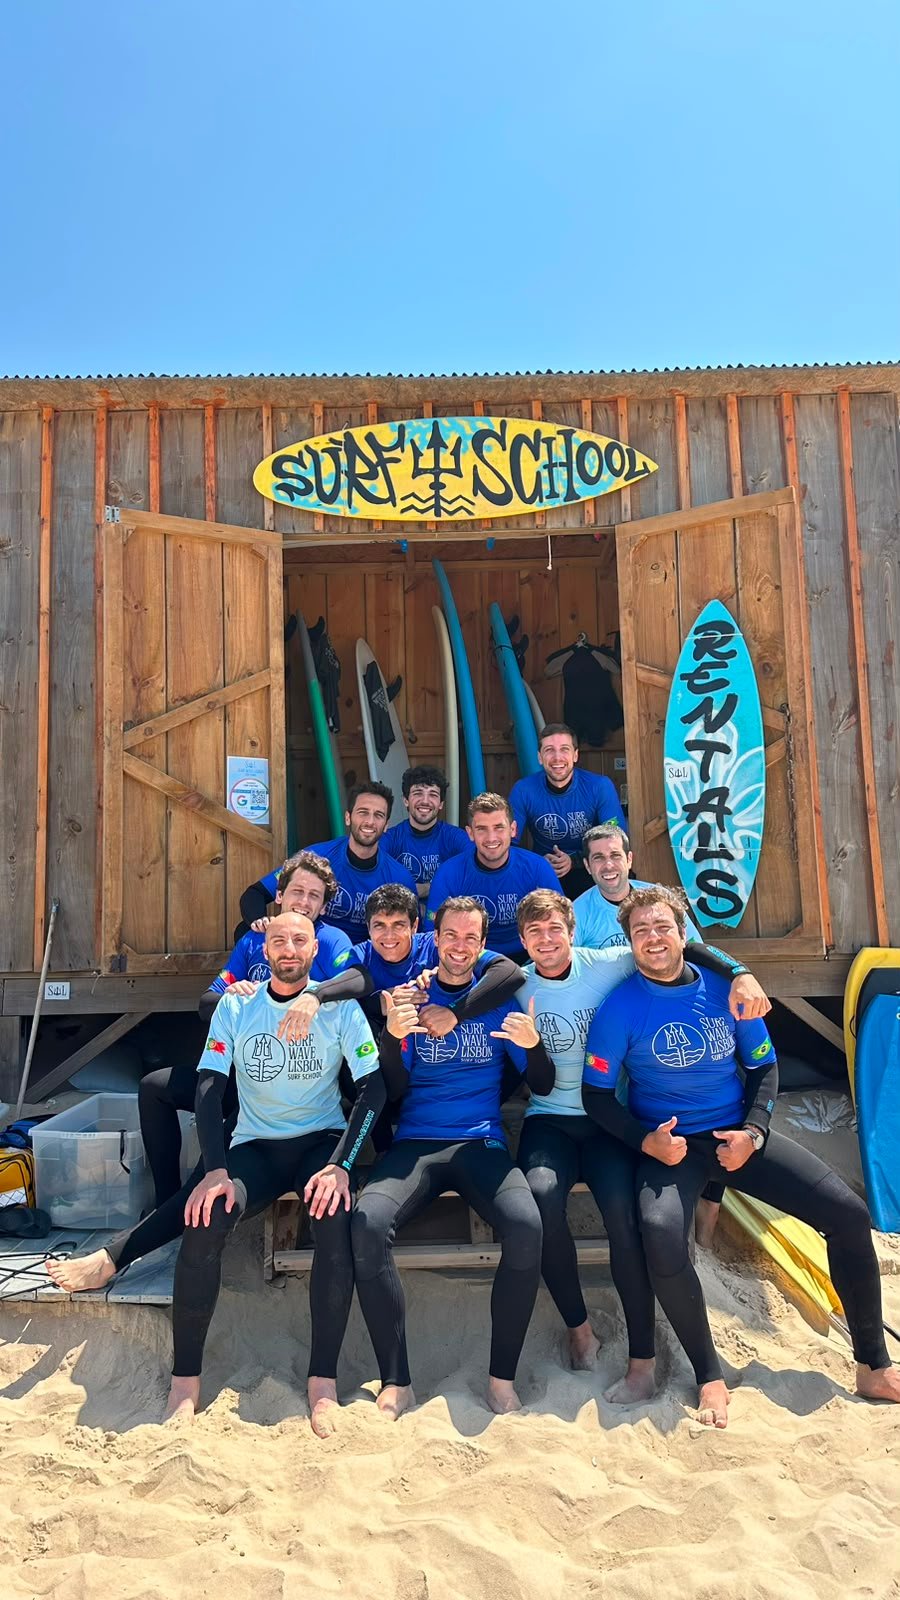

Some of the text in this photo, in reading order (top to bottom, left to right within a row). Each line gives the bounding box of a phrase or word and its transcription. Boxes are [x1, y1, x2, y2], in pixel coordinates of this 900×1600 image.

[271, 419, 649, 508] SURF SCHOOL
[680, 620, 744, 919] RENTALS
[567, 811, 585, 821] SURF
[569, 819, 588, 829] WAVE
[421, 854, 440, 864] SURF
[497, 893, 518, 904] SURF
[354, 901, 366, 911] WA
[499, 911, 517, 921] LISB
[460, 1022, 485, 1035] SURF
[699, 1016, 725, 1030] SURF
[704, 1025, 730, 1042] WAVE
[461, 1034, 488, 1047] WAVE
[288, 1046, 317, 1060] WAVE
[461, 1045, 493, 1058] LISBON
[288, 1059, 323, 1073] LISBON
[287, 1071, 323, 1081] SURF SCHOOL
